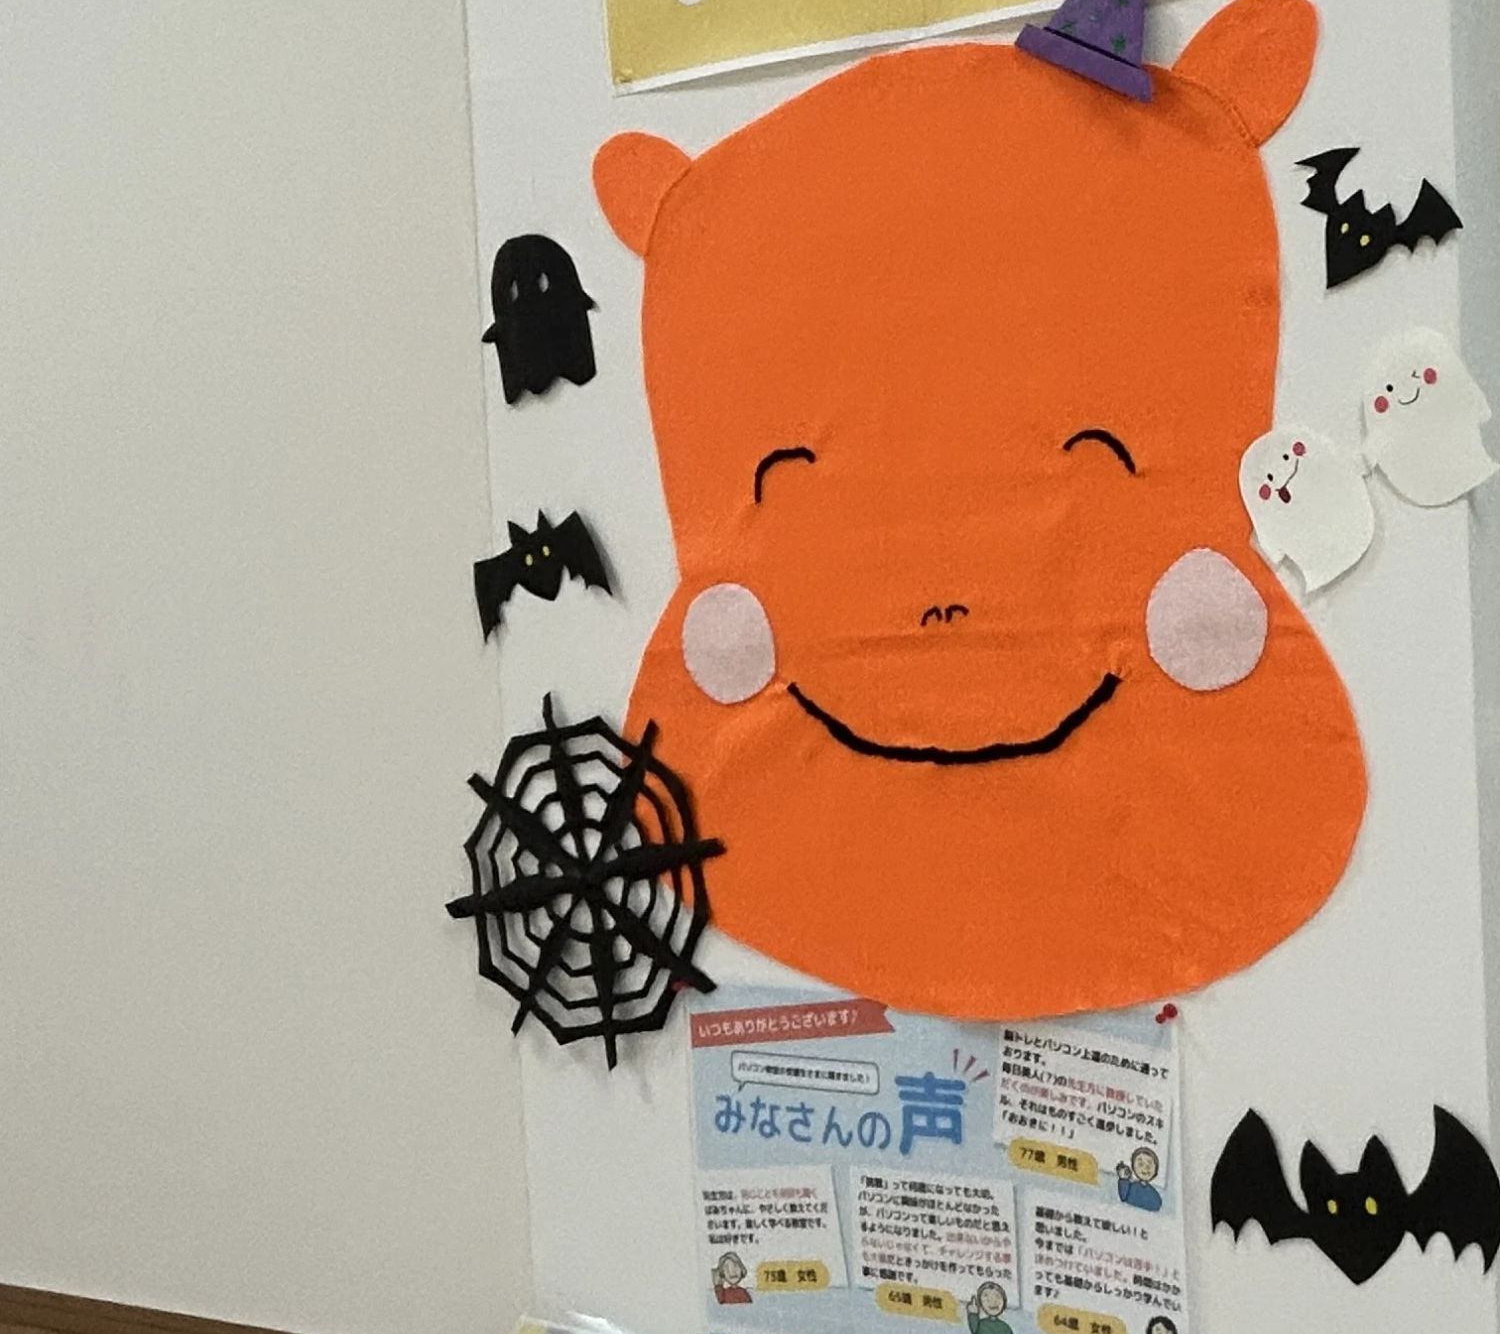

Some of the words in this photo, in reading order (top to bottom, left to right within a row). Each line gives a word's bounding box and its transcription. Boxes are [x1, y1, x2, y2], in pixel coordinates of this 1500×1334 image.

[714, 1071, 967, 1156] みなさんの声
